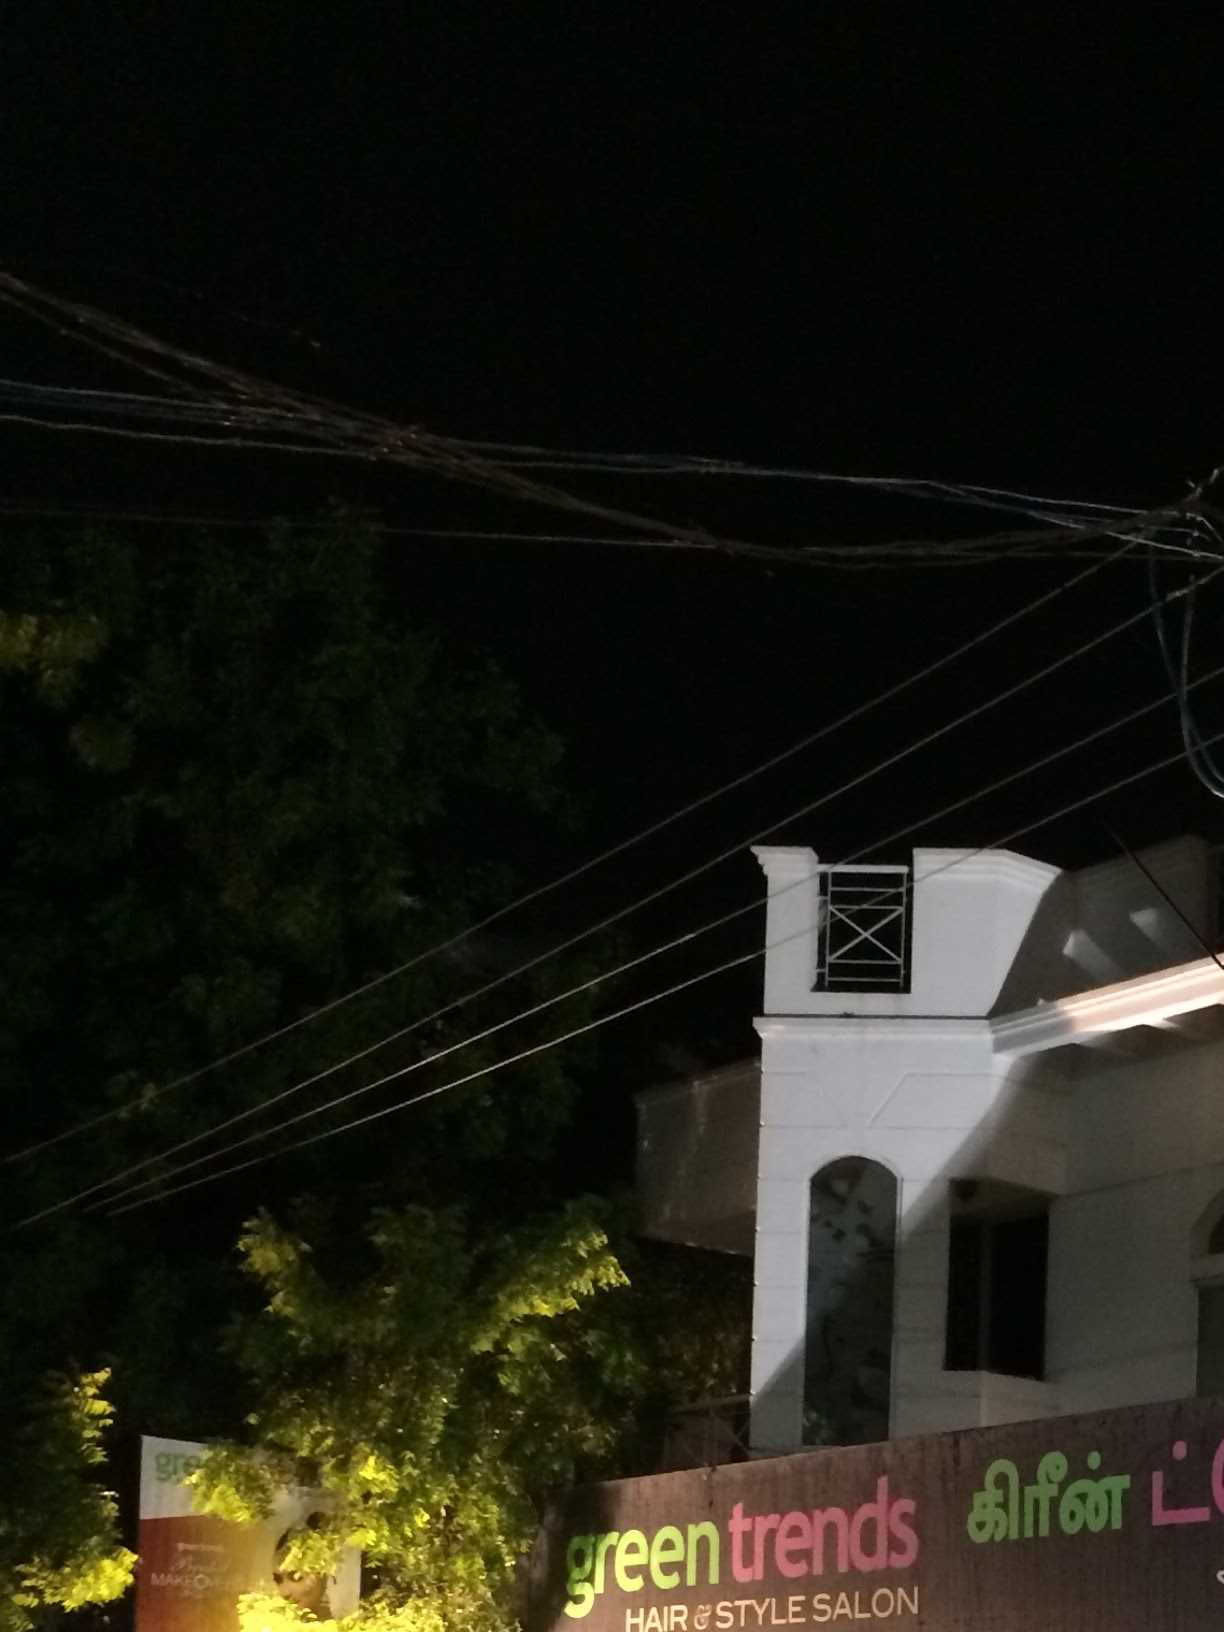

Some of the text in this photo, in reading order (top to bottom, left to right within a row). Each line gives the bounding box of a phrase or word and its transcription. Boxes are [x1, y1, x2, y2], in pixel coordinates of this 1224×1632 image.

[966, 1450, 1131, 1544] கிரீன்
[563, 1474, 919, 1619] green trends
[694, 1604, 713, 1630] &
[715, 1596, 806, 1629] STYLE
[812, 1586, 920, 1623] SALON
